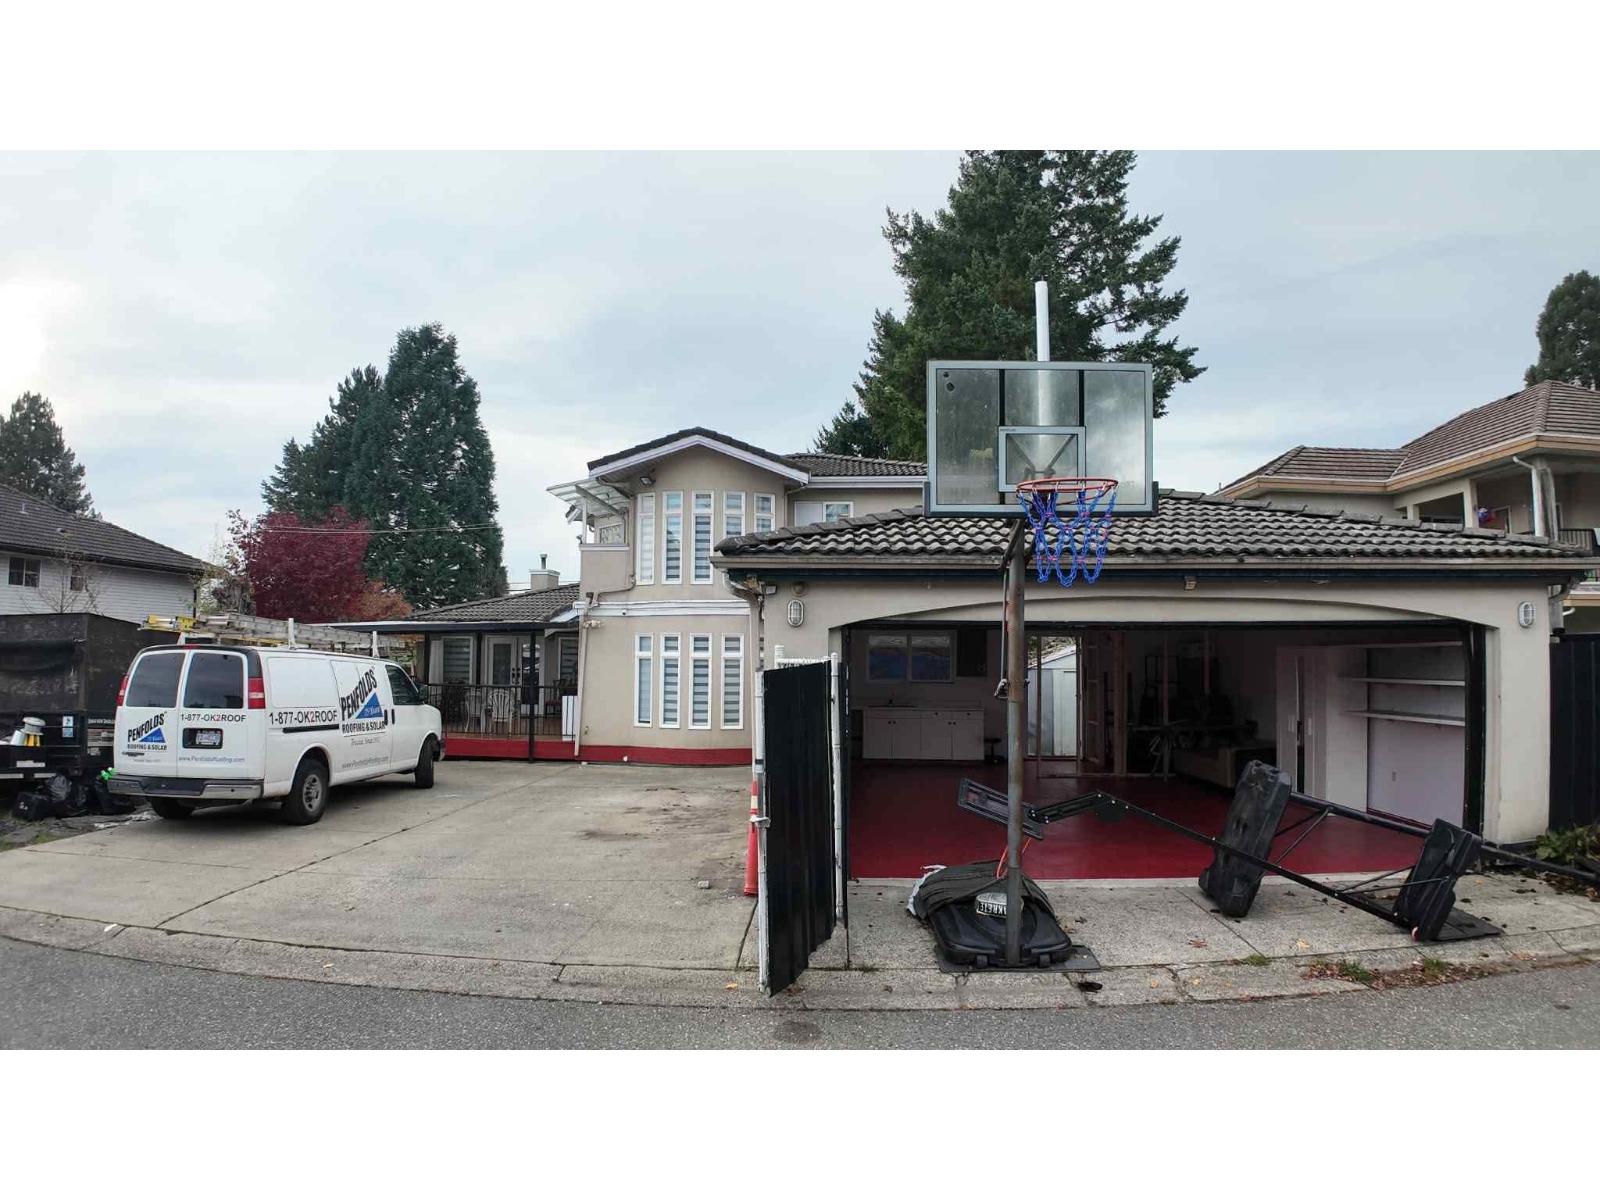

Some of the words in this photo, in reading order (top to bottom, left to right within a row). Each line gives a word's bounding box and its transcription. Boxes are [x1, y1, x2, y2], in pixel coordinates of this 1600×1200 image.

[340, 668, 378, 721] PENFOLDS
[181, 714, 247, 723] 1-877-OK2ROOF
[269, 710, 338, 725] 1-877-OK2ROOF
[127, 713, 165, 742] PENFOLDS
[342, 723, 365, 734] ROOFING
[369, 721, 386, 732] SOLAR
[980, 902, 1007, 915] AKRETE
